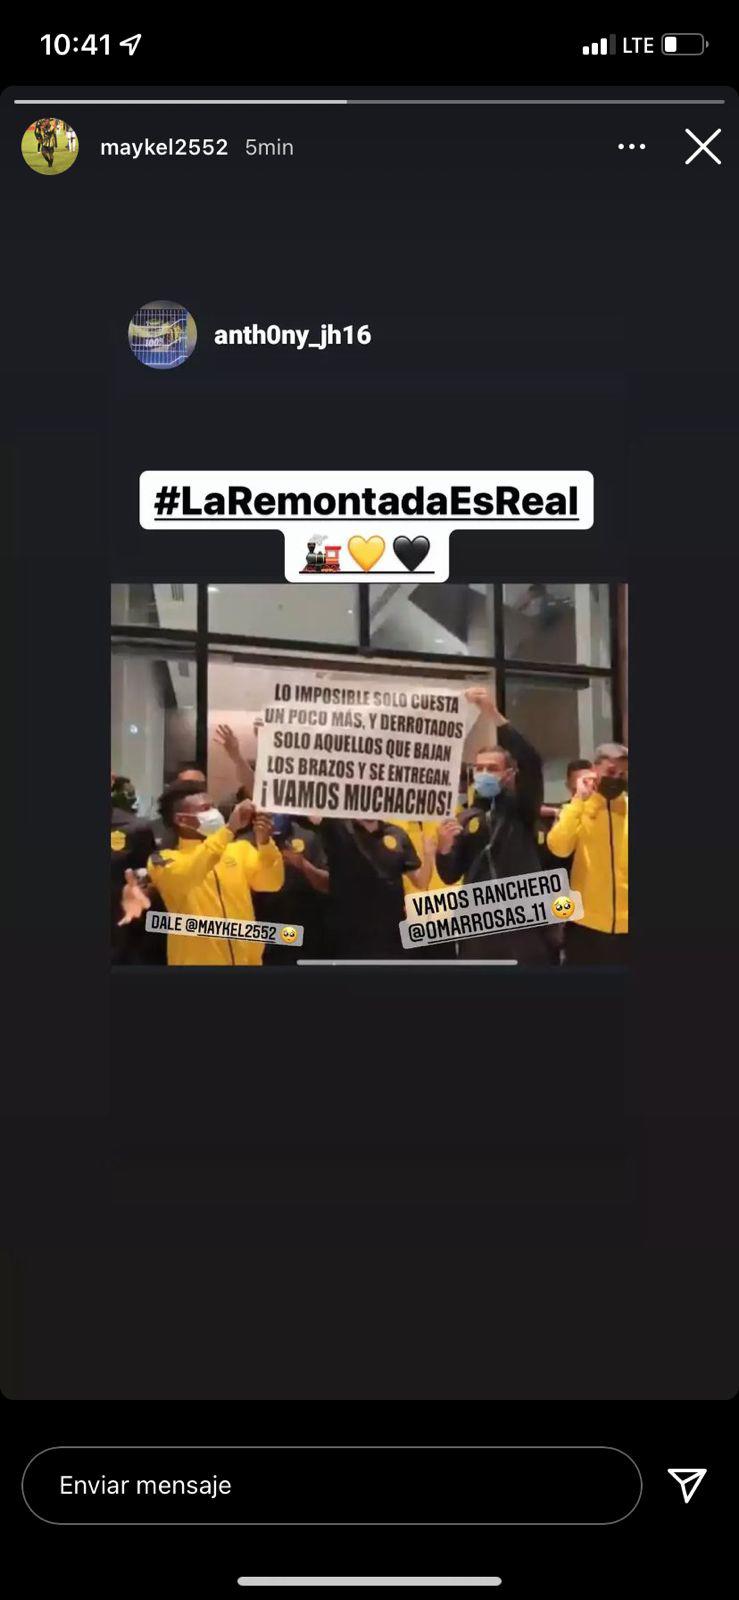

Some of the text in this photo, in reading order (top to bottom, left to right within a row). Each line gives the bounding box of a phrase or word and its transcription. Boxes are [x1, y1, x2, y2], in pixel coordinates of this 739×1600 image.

[41, 34, 109, 55] 10:41
[623, 37, 654, 54] LTE
[101, 138, 294, 160] maykel2552 5min
[214, 323, 372, 350] anth0ny_jh16
[275, 683, 459, 713] LO IMPOSIBLE SOLO CUESTA
[265, 708, 464, 739] UN POCO MÁS, Y DERROTADOS
[274, 731, 452, 762] SOLO AQUELLOS QUE BAJAN
[267, 756, 452, 786] LOS BRAZOS Y SE ENTREGAN.
[273, 778, 340, 810] VAMOS
[344, 784, 453, 816] MUCHACHOS!
[60, 1474, 232, 1499] Enviar mensaje
